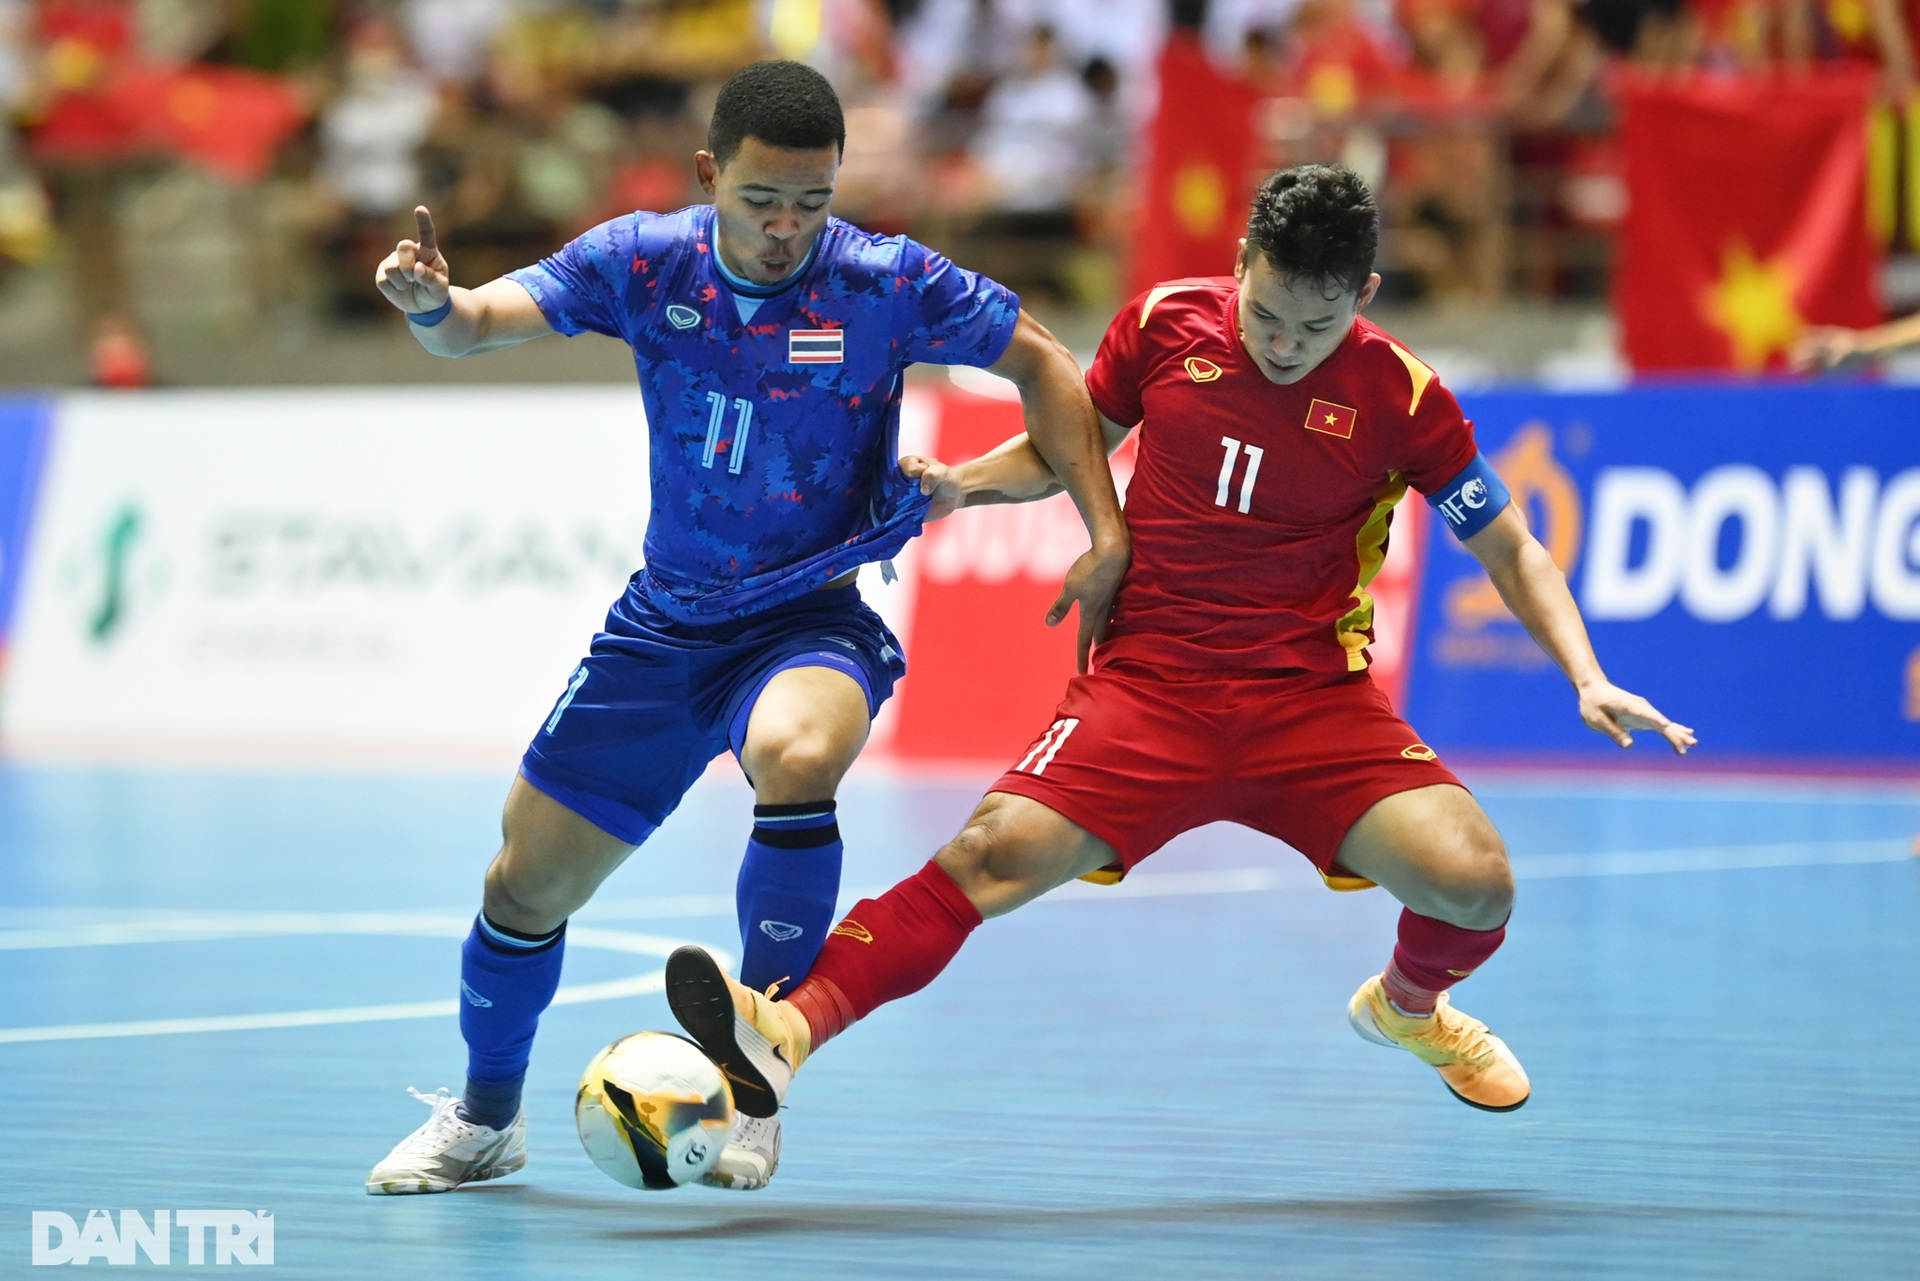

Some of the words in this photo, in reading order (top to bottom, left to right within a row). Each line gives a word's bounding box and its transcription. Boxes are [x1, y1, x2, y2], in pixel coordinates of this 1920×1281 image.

[701, 390, 753, 475] 11
[1215, 436, 1264, 514] 11
[1438, 477, 1488, 528] AFC
[545, 663, 589, 735] 1
[1015, 718, 1080, 775] 11
